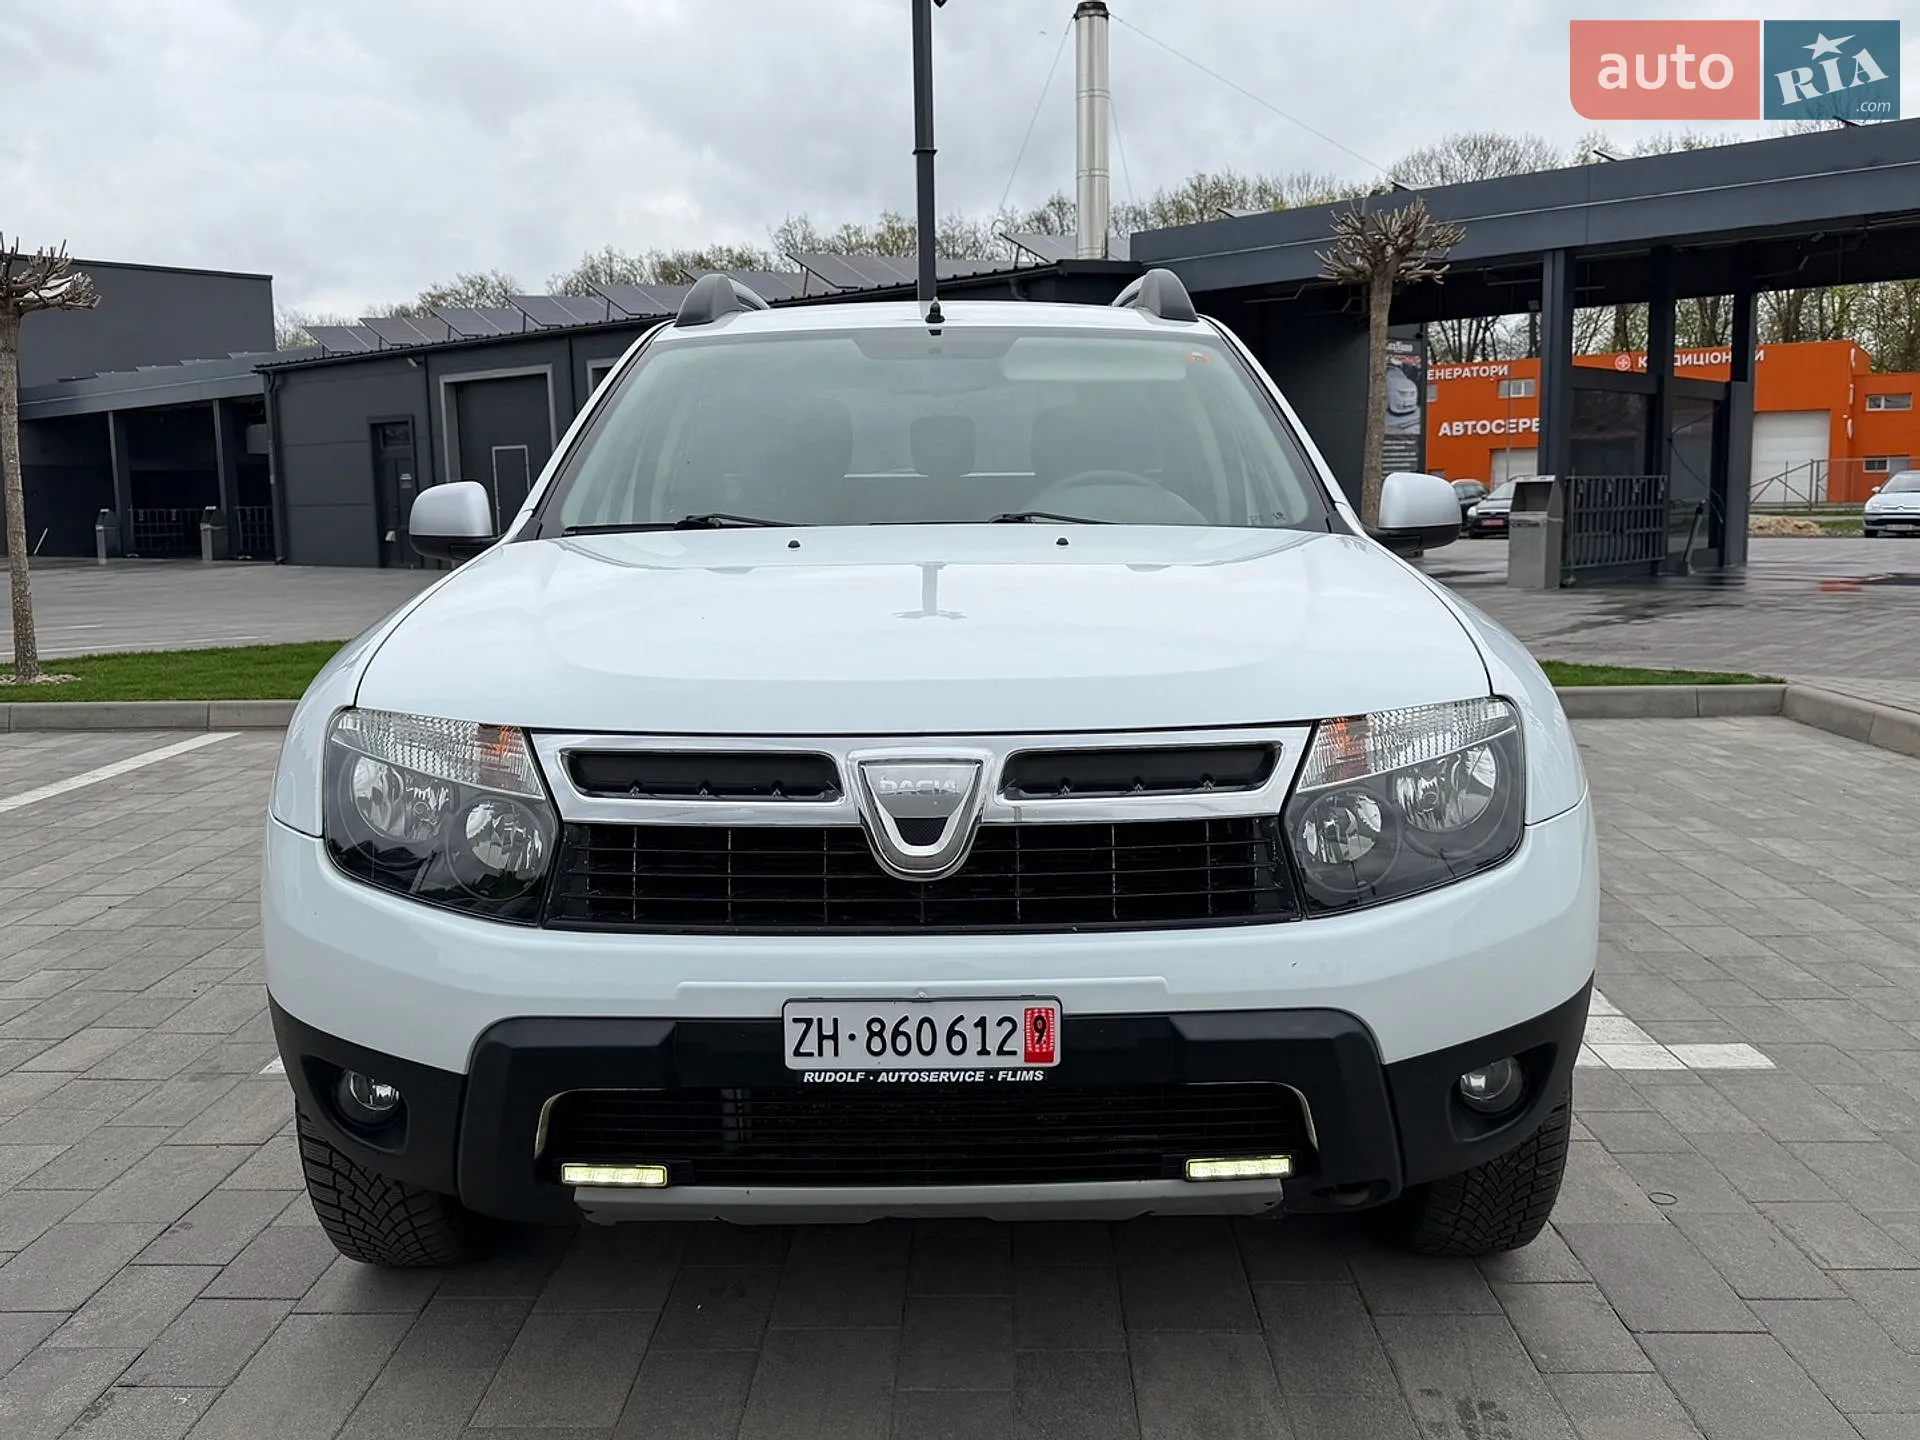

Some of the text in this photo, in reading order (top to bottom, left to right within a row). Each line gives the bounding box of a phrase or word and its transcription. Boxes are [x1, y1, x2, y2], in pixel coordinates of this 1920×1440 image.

[1427, 365, 1509, 381] ЕНЕРАТОРИ
[1033, 1014, 1047, 1045] 9
[803, 1071, 865, 1082] RUDOLF
[877, 1071, 985, 1082] AUTOSERVICE
[997, 1070, 1044, 1081] FLIMS
